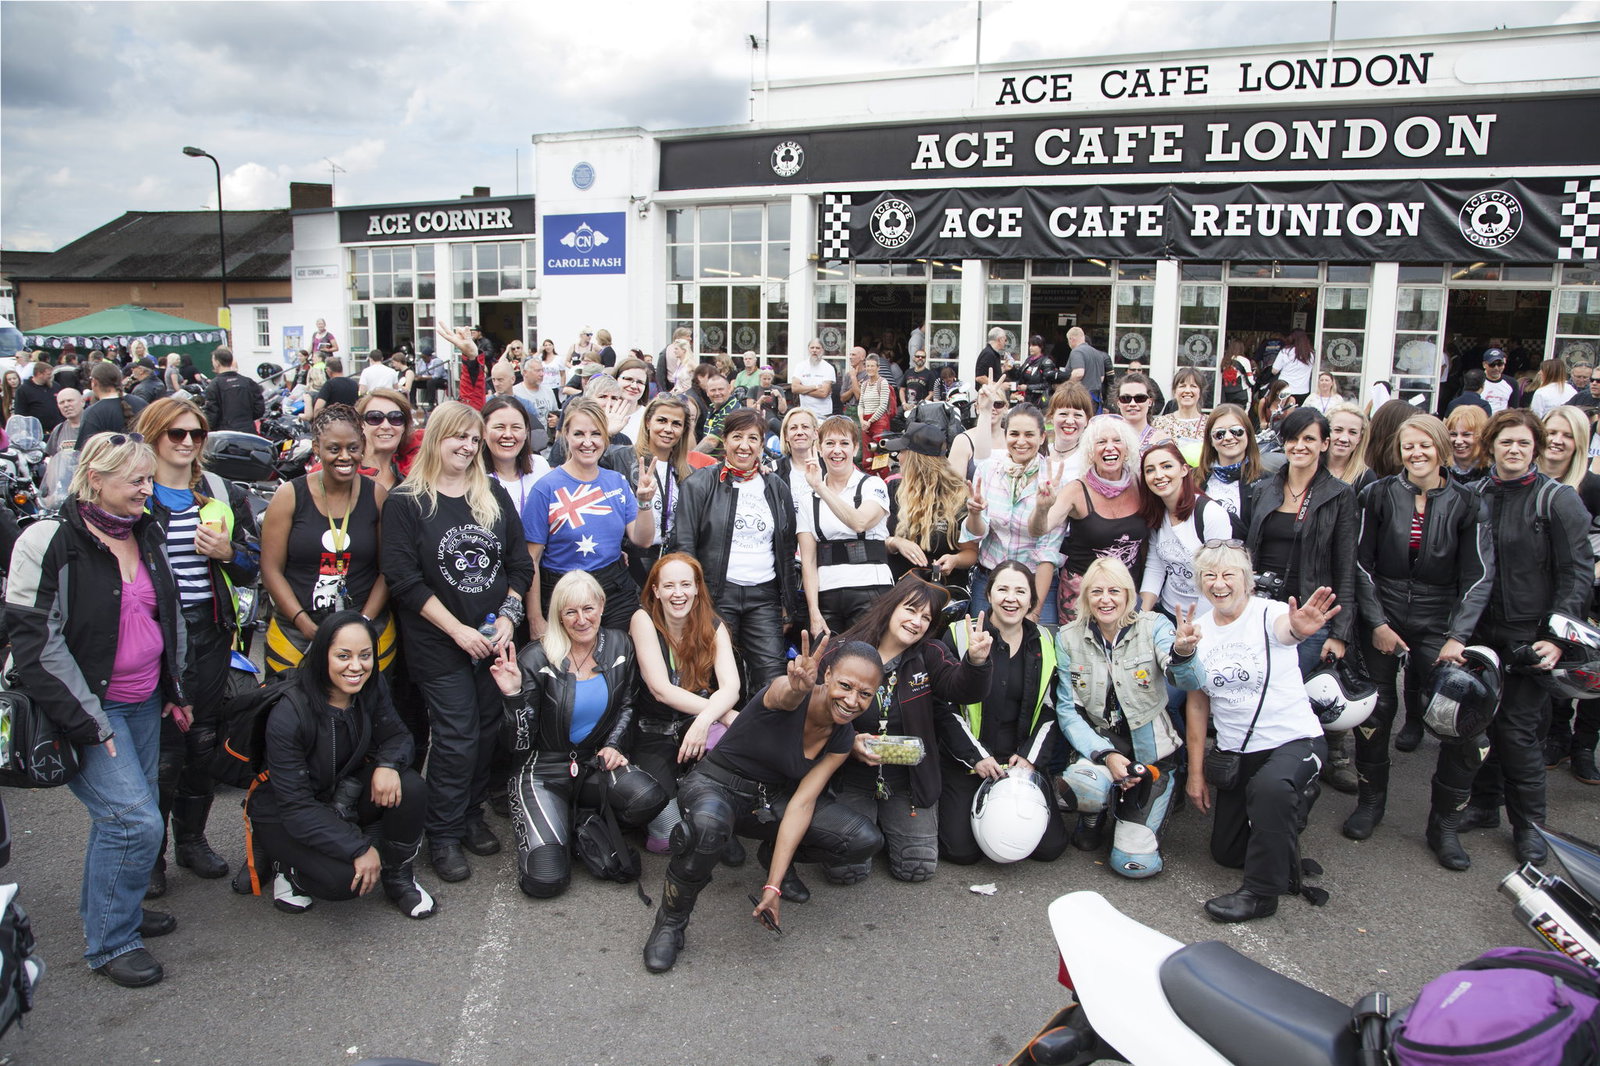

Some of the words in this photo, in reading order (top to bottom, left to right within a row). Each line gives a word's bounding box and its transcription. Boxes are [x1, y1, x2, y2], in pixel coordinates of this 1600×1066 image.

[995, 73, 1073, 106] ACE
[1100, 65, 1209, 99] CAFE
[1238, 52, 1434, 92] LONDON
[911, 130, 1014, 170] ACE
[1034, 124, 1184, 166] CAFE
[1205, 113, 1497, 162] LONDON
[874, 202, 891, 220] ACE
[892, 201, 913, 219] CAFE
[1465, 194, 1488, 215] ACE
[1491, 192, 1519, 214] CAFE
[366, 213, 411, 236] ACE
[415, 207, 513, 233] CORNER
[939, 206, 1022, 238] ACE
[1049, 204, 1164, 238] CAFE
[1190, 202, 1425, 237] REUNION
[576, 235, 592, 247] CN
[874, 230, 910, 246] LONDON
[1465, 226, 1515, 246] LONDON
[548, 258, 590, 268] CAROLE
[592, 257, 622, 267] NASH
